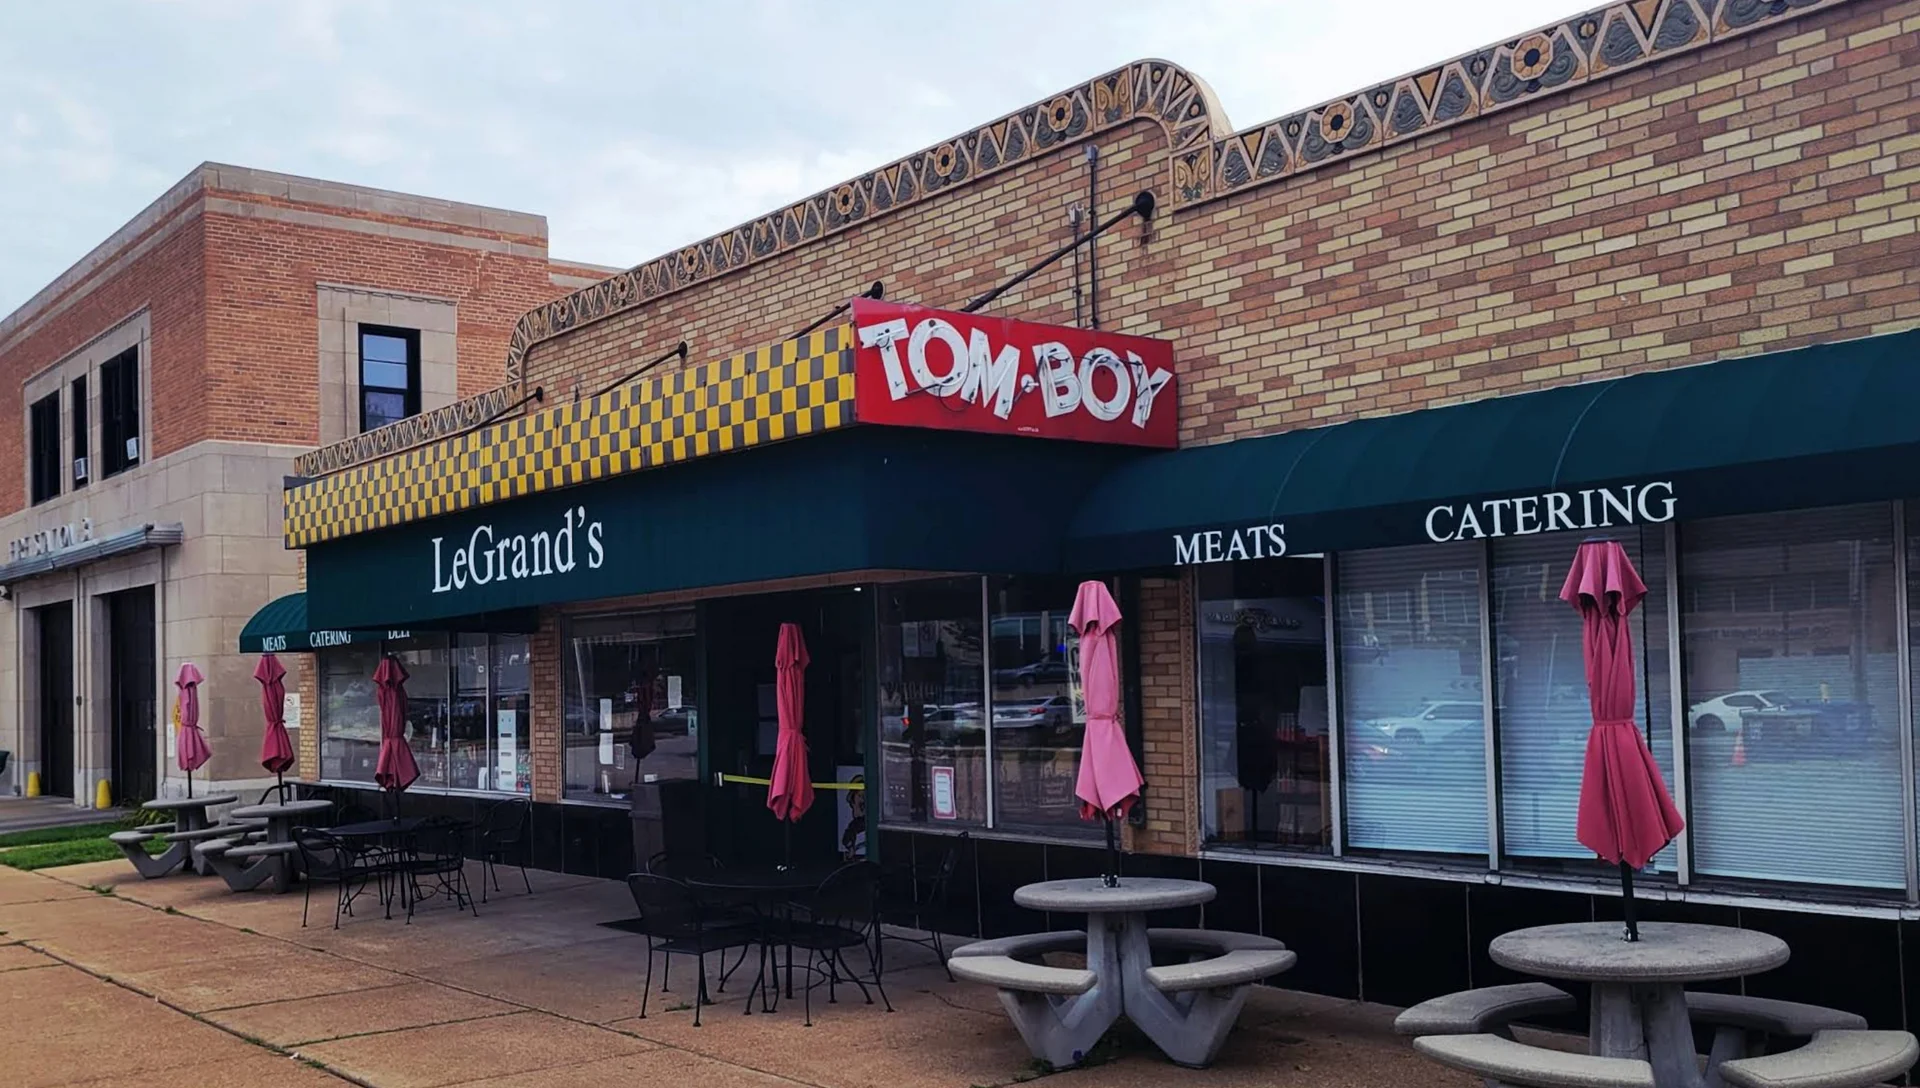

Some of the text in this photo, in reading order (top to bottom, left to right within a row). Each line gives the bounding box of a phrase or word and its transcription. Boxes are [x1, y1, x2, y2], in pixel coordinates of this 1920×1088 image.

[1425, 481, 1677, 542] CATERING
[432, 506, 604, 593] LeGrand's
[1173, 523, 1287, 565] MEATS
[262, 635, 287, 652] MEATS
[310, 630, 352, 648] CATERING
